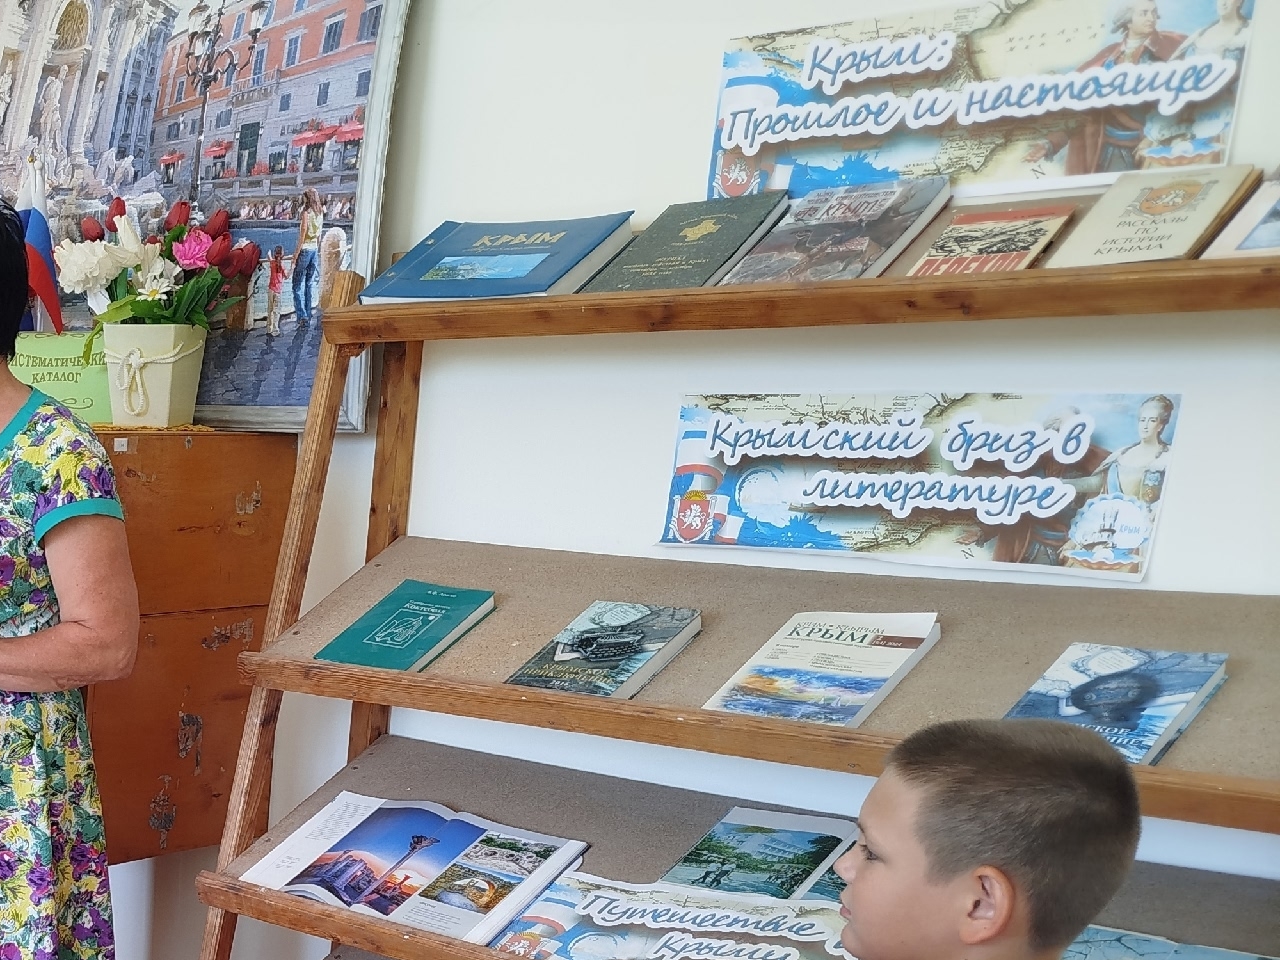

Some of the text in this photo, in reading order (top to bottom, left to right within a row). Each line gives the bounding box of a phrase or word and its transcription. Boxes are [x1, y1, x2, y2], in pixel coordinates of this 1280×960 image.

[807, 38, 949, 87] Крым:
[718, 61, 1227, 148] Прошлое и настоящее
[1116, 215, 1189, 228] РАССКАЗЫ
[1134, 226, 1159, 235] ПО
[471, 229, 568, 247] КРЫМ
[1102, 233, 1173, 246] ИСТОРИИ
[1093, 242, 1164, 256] КРЫМА
[31, 371, 82, 385] КАТАЛОГ
[709, 417, 1088, 464] Крымский бриз в
[802, 477, 1069, 517] литературе
[786, 626, 870, 644] КРЫМ
[582, 893, 826, 937] Путешествие
